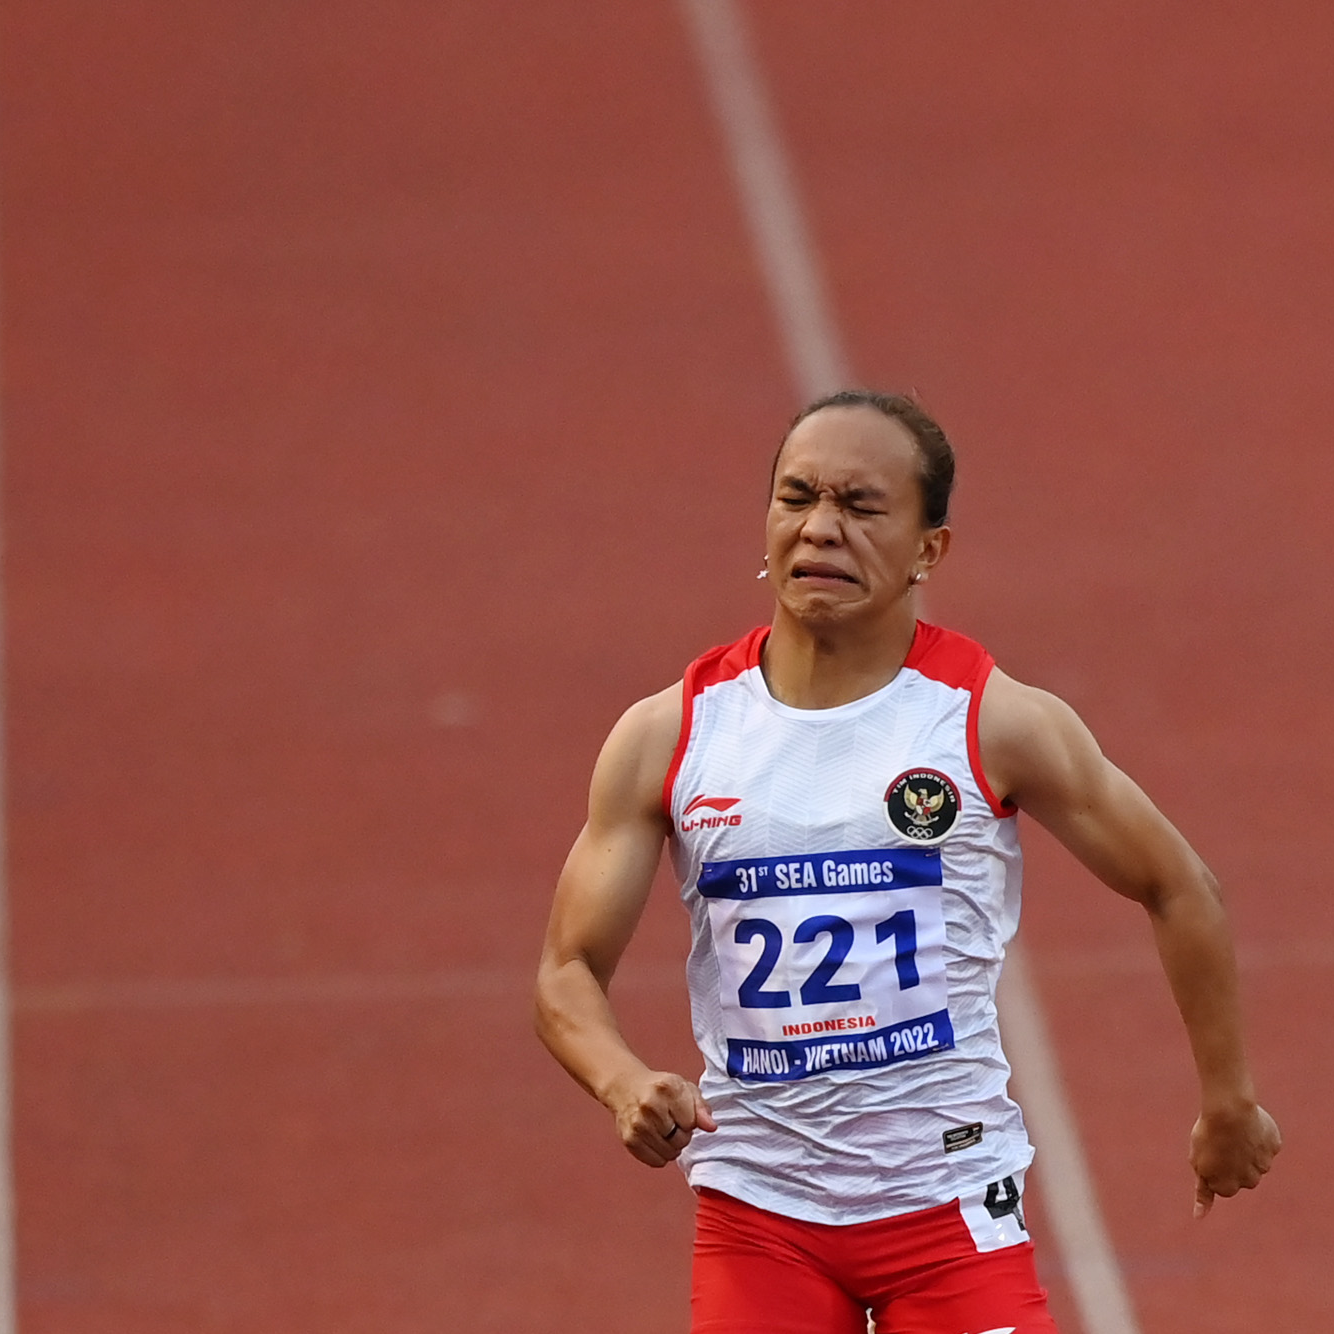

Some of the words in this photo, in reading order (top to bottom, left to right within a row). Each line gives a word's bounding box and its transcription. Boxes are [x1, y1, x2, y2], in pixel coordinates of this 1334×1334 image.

[892, 778, 908, 795] TIM
[909, 773, 956, 803] INDONESIA
[681, 815, 742, 832] LI-NING
[774, 862, 817, 890] SEA
[822, 859, 894, 887] Games
[734, 909, 920, 1009] 221
[782, 1015, 876, 1036] INDONESIA
[742, 1046, 789, 1074] HANOI
[804, 1036, 888, 1071] VIETNAM
[890, 1022, 939, 1057] 2022
